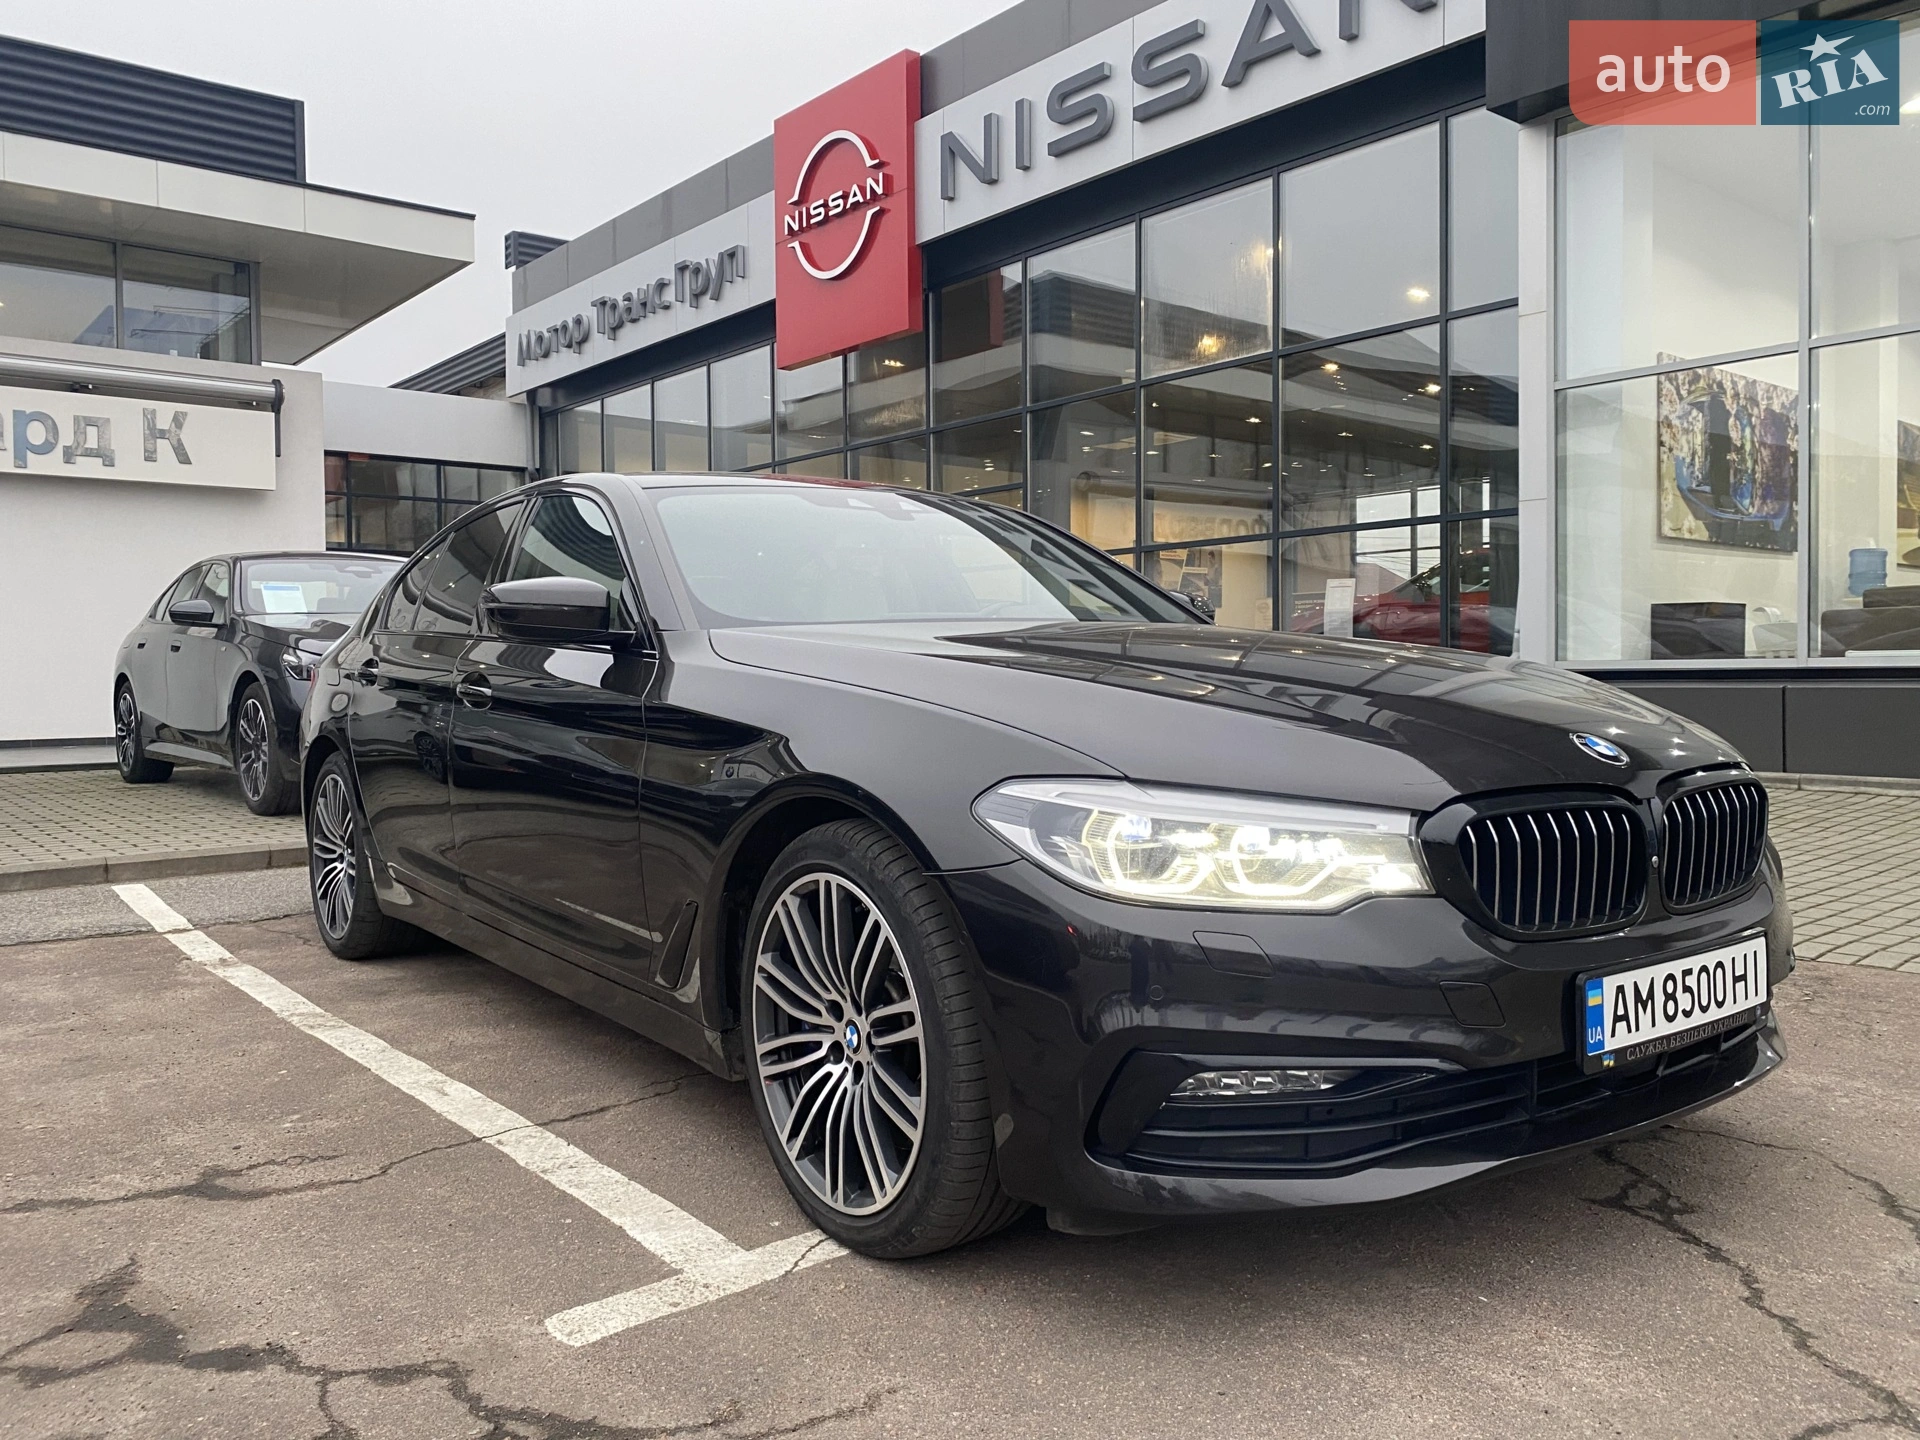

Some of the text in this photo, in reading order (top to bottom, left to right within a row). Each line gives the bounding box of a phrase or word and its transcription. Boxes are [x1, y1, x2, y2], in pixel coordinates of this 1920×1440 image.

[784, 172, 884, 236] NISSAN
[517, 244, 746, 366] Мотор Транс Груп
[0, 407, 192, 468] рд К
[1588, 1026, 1603, 1044] UA
[1626, 1039, 1668, 1061] СЛУЖБА
[1670, 1024, 1711, 1048] БЕЗПЕКИ
